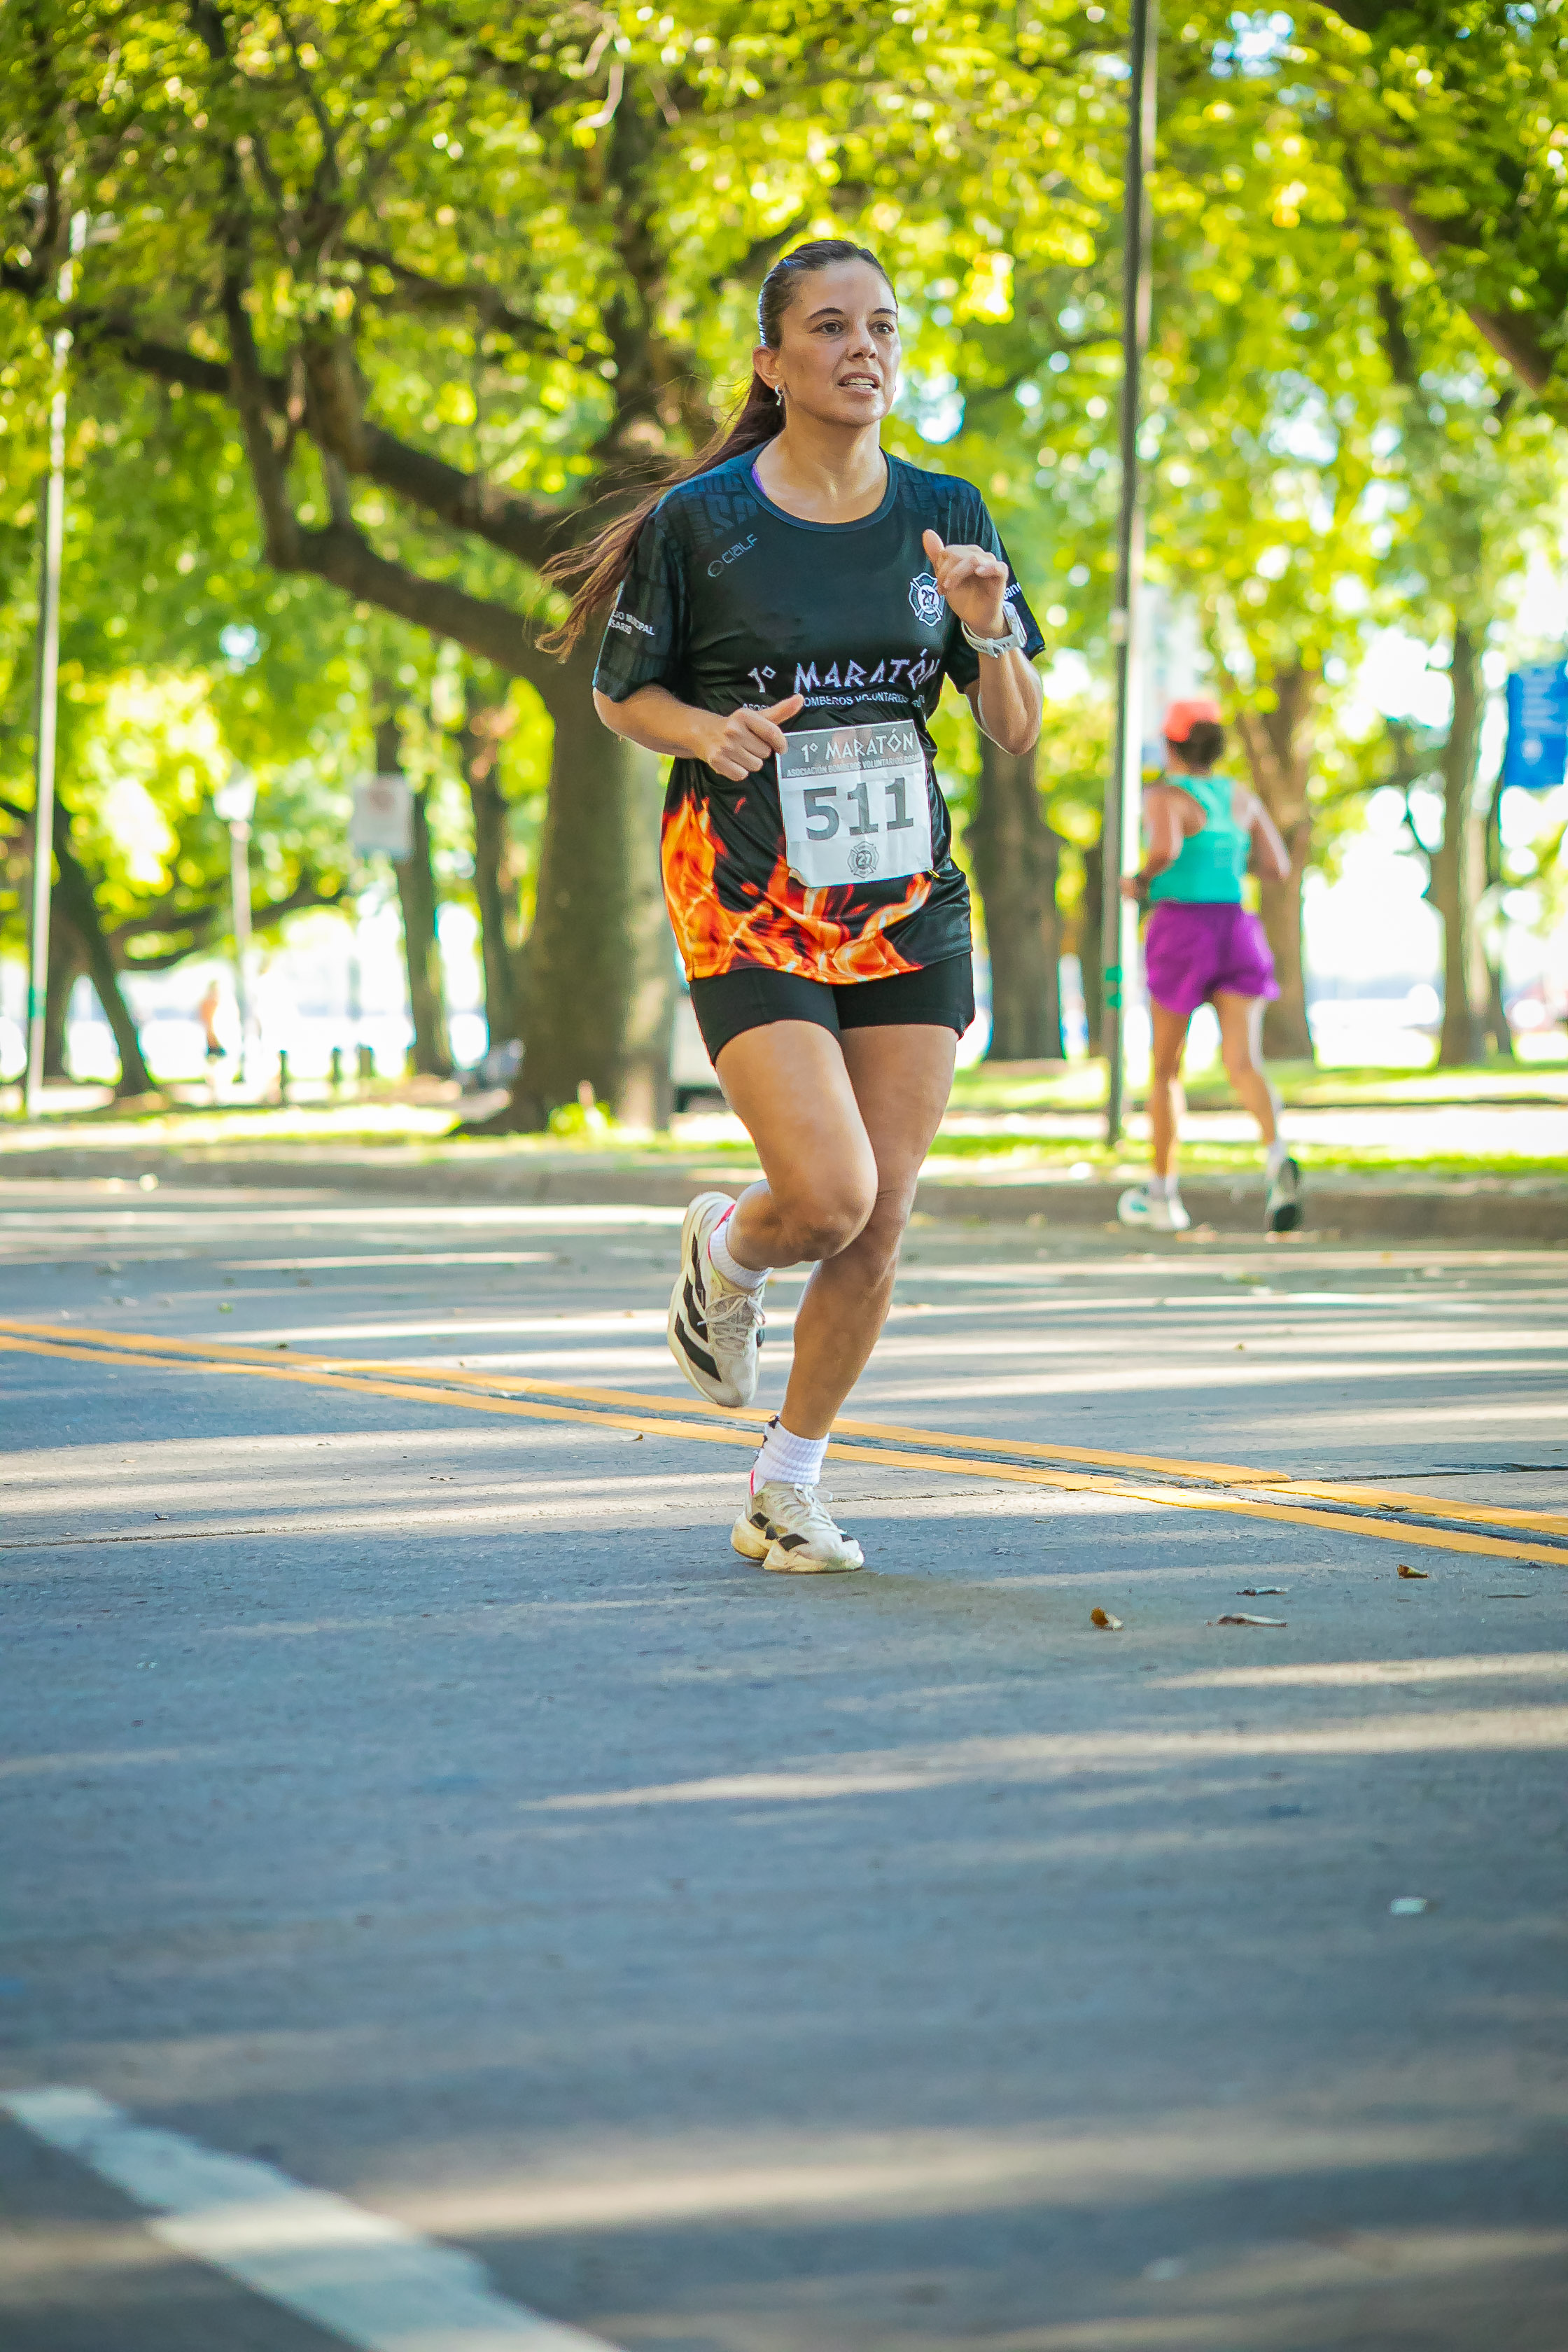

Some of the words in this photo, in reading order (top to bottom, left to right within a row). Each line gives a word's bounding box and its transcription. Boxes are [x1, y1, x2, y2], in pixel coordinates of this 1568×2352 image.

[804, 695, 854, 707] OMBEROS
[825, 727, 914, 761] MARATÓN
[862, 756, 904, 769] VOLUNTARIOS
[803, 777, 914, 840] 511
